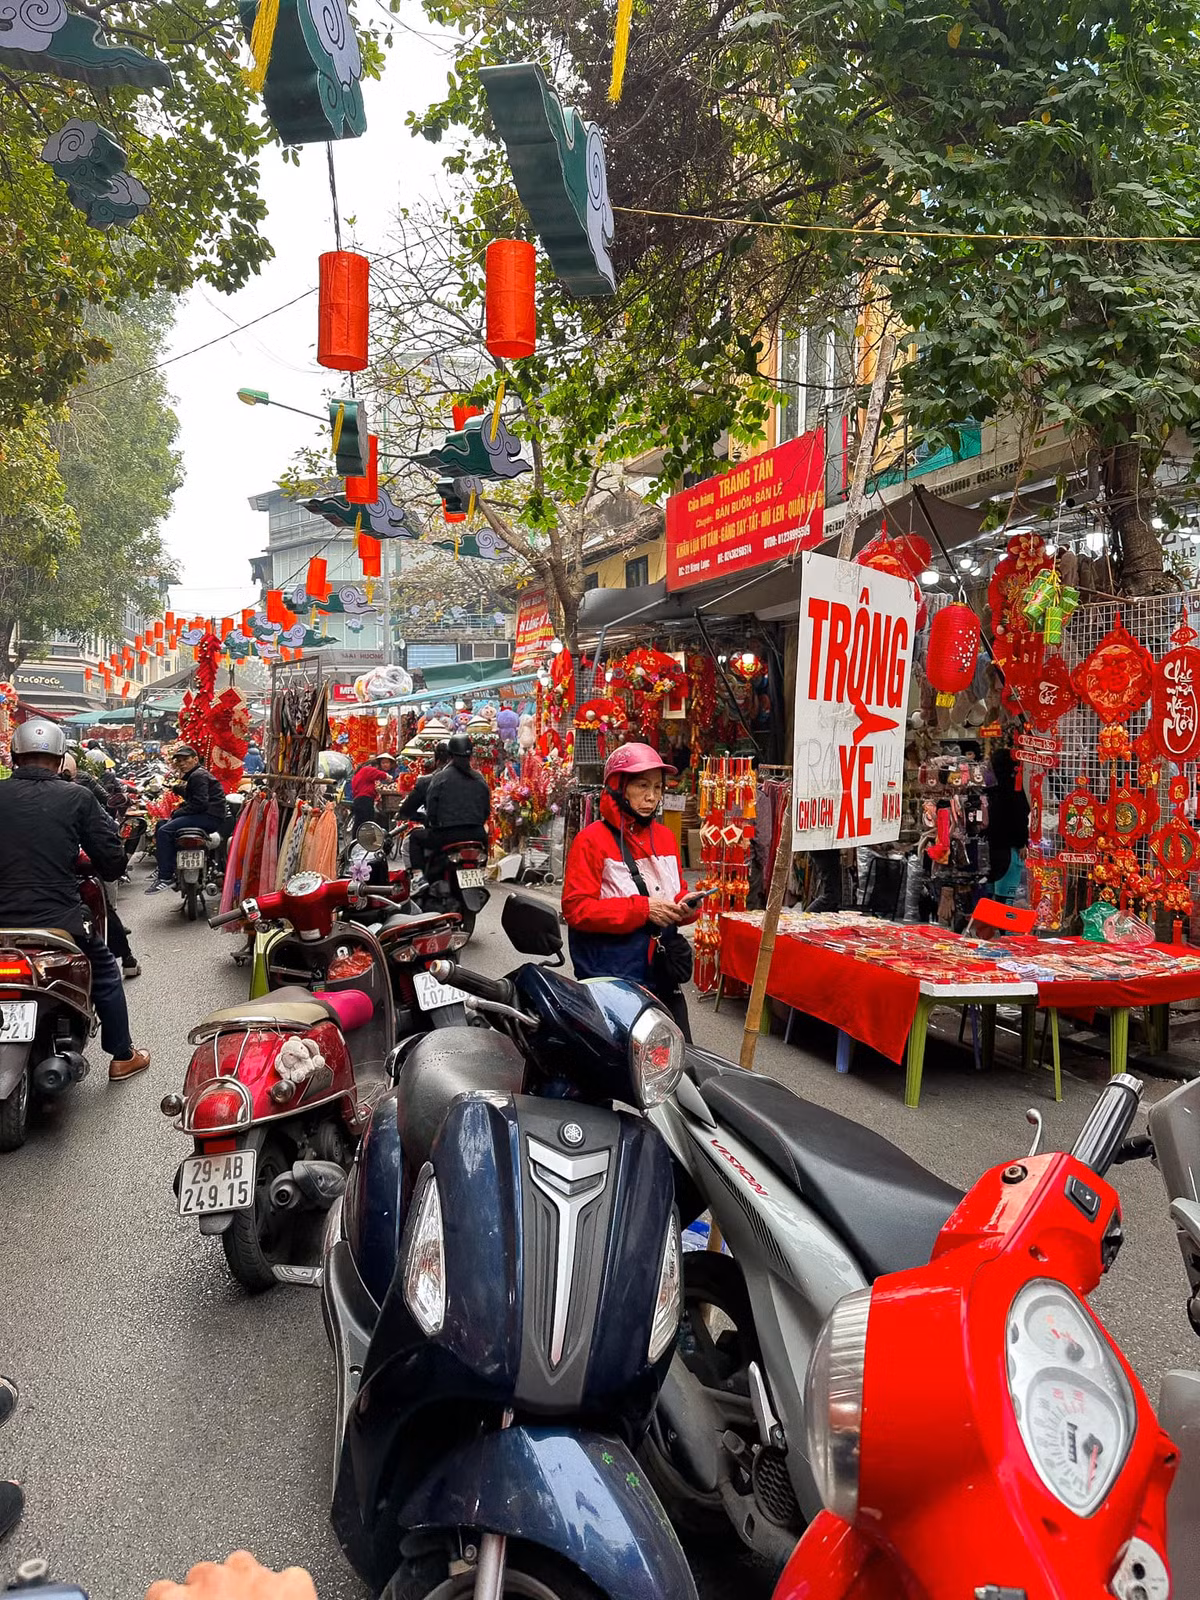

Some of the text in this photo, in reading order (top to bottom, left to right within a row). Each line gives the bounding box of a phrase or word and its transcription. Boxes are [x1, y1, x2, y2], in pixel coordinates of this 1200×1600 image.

[715, 503, 730, 520] BÁN
[731, 495, 752, 514] BUÔN
[755, 486, 771, 504] BÁN
[773, 477, 783, 497] LẺ
[719, 468, 751, 499] TRANG
[753, 458, 774, 484] TÂN
[772, 504, 785, 524] LEN
[808, 587, 909, 708] TRÔNG
[836, 744, 874, 840] XE
[191, 1155, 244, 1185] 29-AB
[710, 1139, 768, 1197] VISION
[183, 1180, 249, 1212] 249.15
